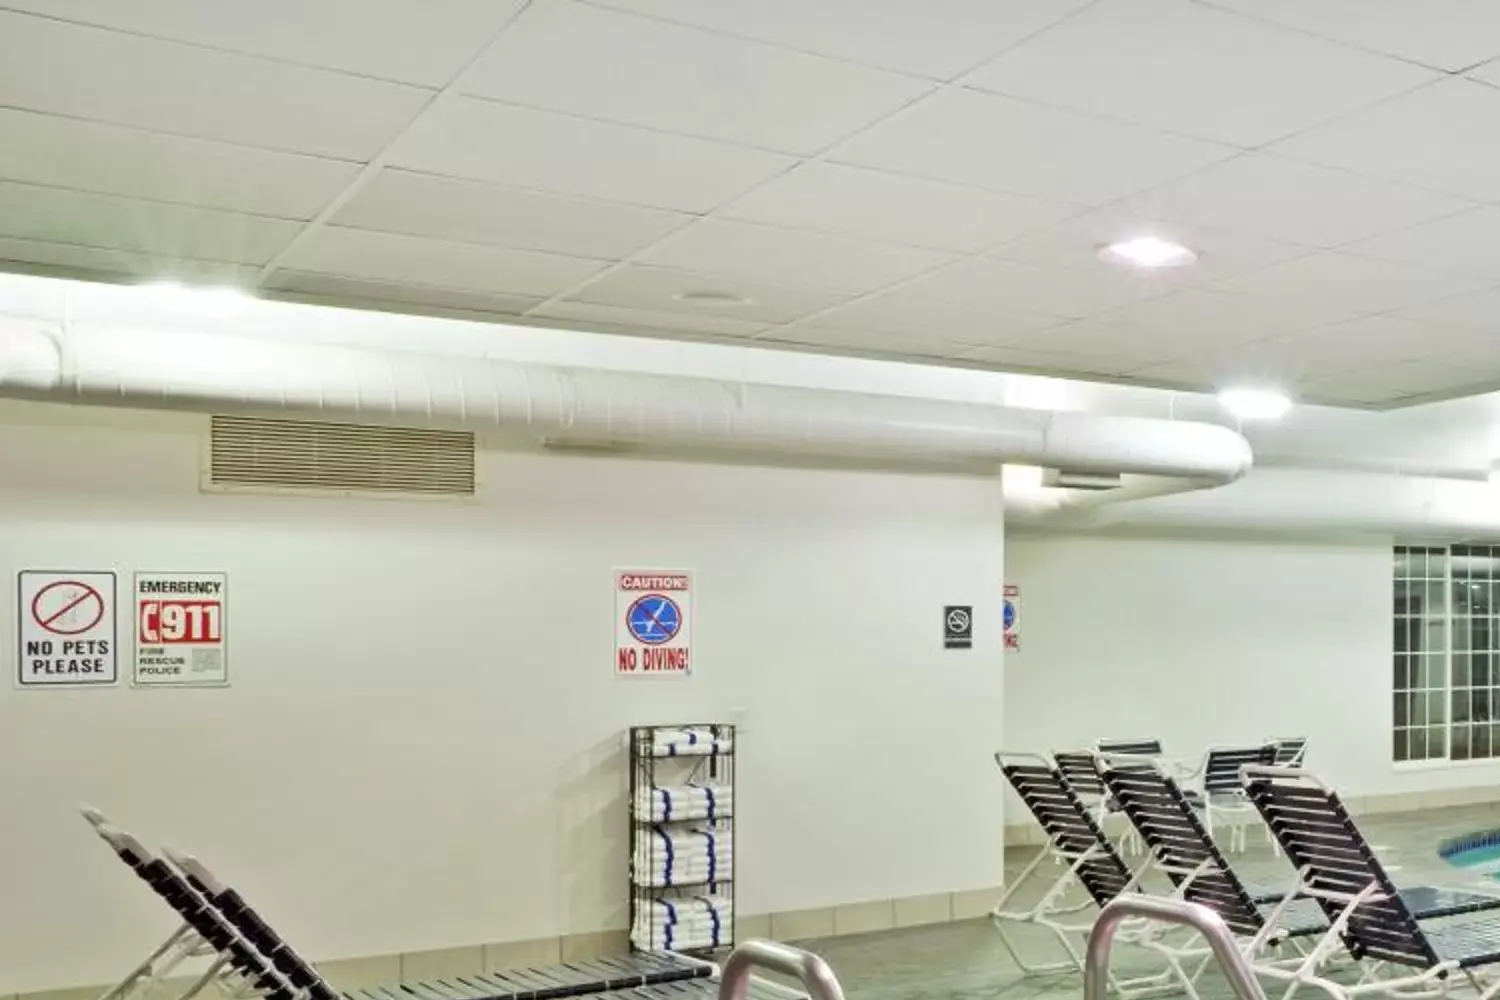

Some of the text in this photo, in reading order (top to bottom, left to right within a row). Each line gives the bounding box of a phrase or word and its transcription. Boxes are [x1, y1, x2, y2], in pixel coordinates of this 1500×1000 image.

[139, 581, 222, 594] EMERGENCY
[162, 604, 219, 641] 911
[27, 640, 109, 656] NO PETS
[32, 659, 105, 675] PLEASE
[140, 657, 185, 665] RESCUE
[619, 647, 689, 671] NO DIVING!
[140, 667, 181, 675] POLICE
